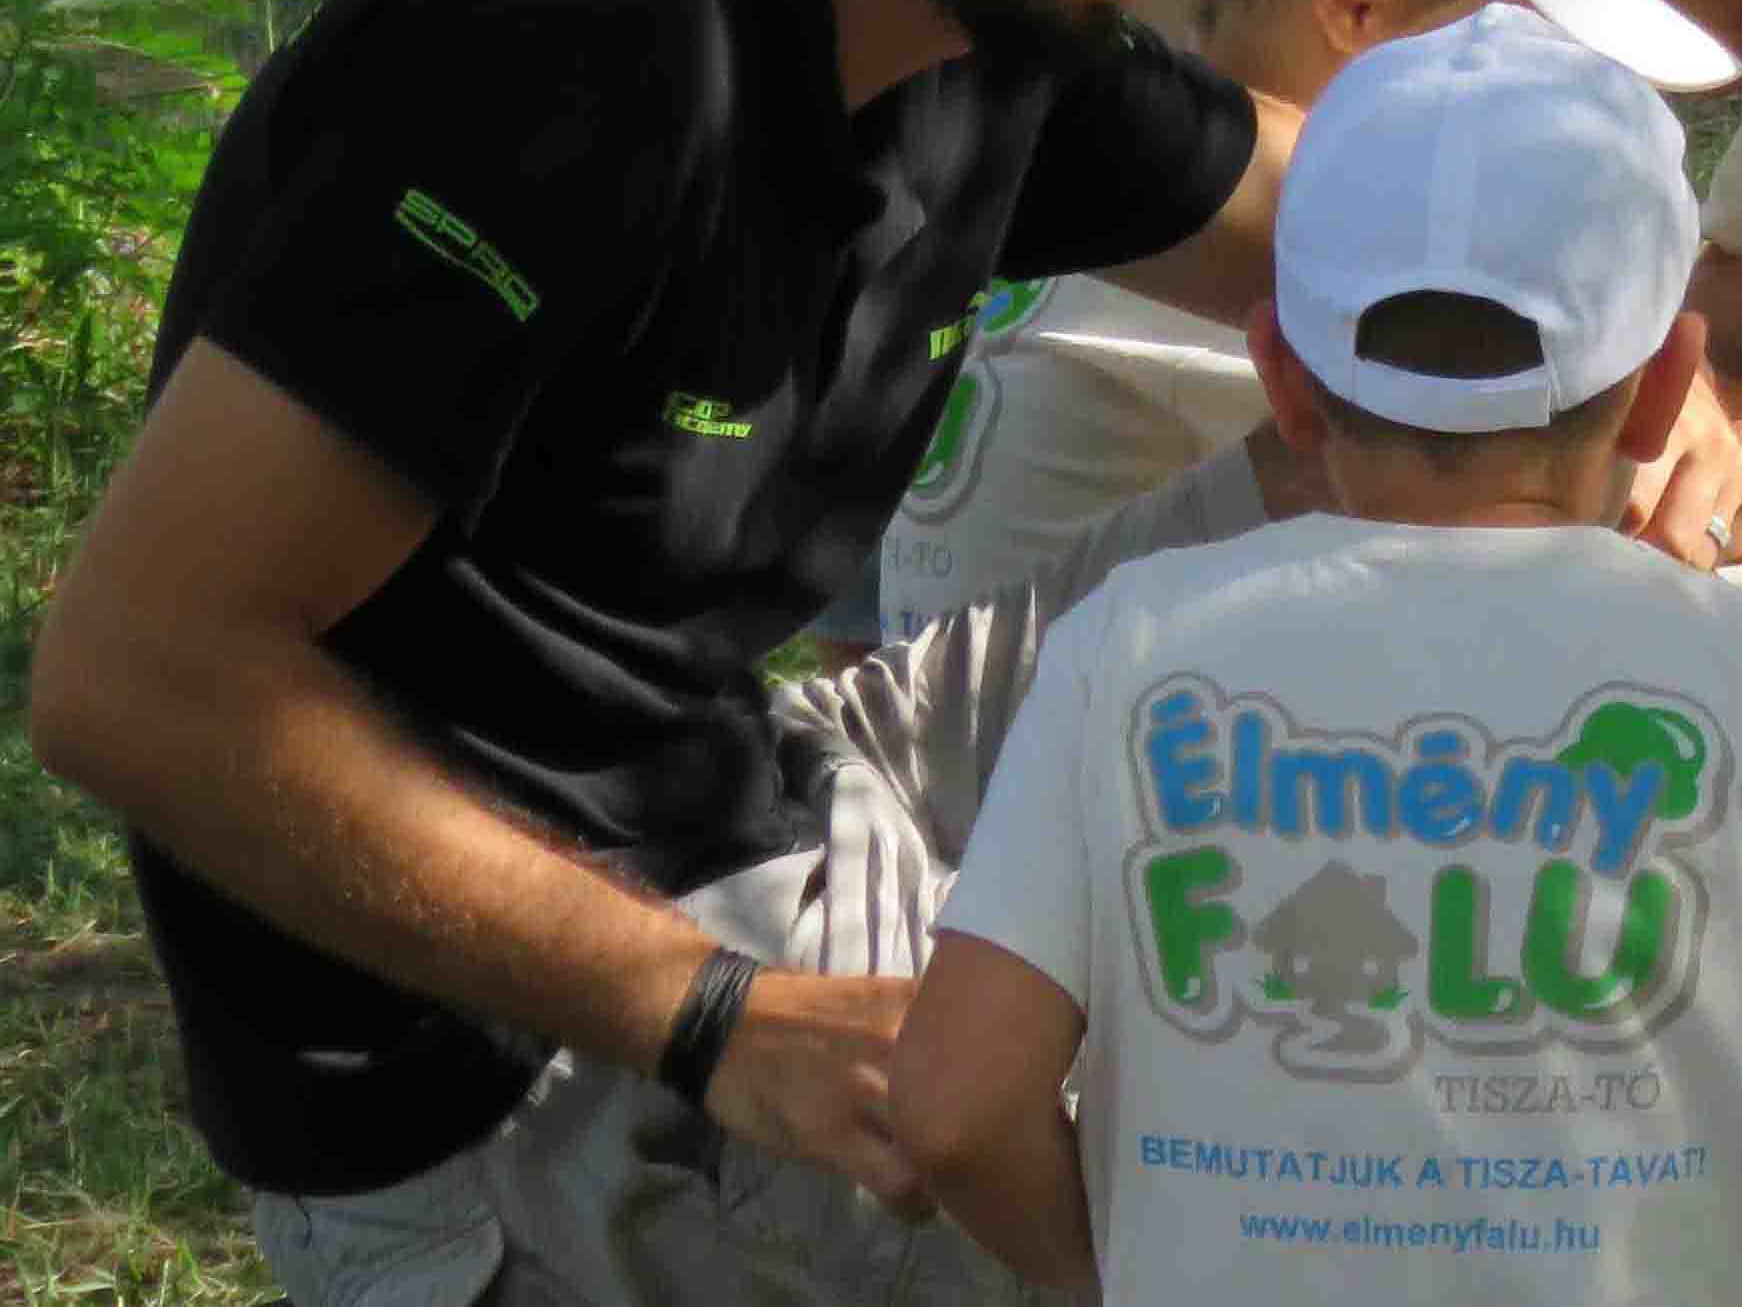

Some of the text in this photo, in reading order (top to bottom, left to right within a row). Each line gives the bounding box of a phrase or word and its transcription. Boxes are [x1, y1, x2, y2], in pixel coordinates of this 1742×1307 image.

[1139, 1134, 1404, 1189] BEMUTATJUK
[1416, 1155, 1446, 1187] A
[1240, 1212, 1600, 1254] www.elmenyfalu.hu
